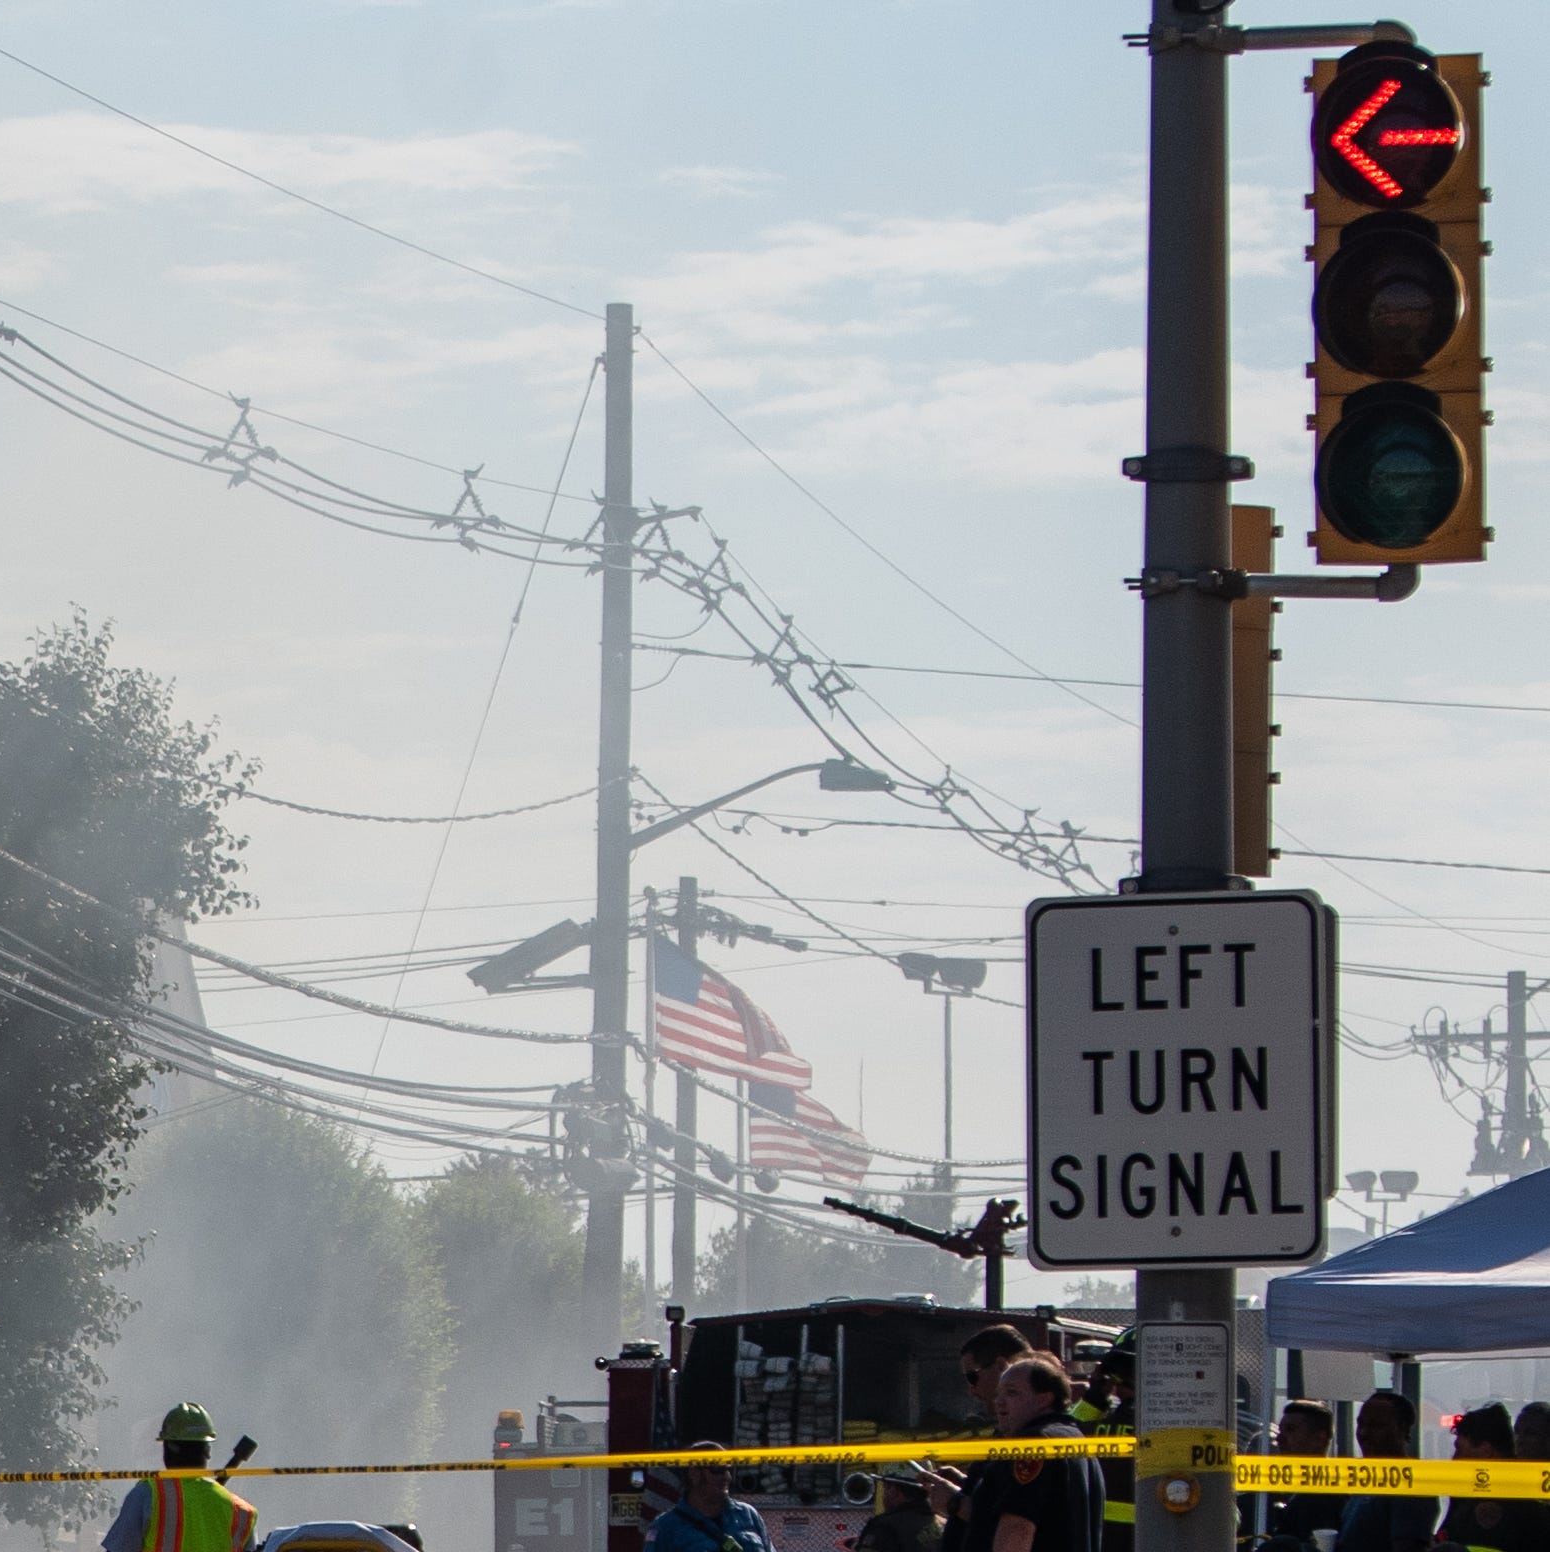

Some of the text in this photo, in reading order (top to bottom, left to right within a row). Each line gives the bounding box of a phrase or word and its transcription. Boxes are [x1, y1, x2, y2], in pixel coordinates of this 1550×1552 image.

[1092, 943, 1255, 1011] LEFT
[1082, 1046, 1268, 1114] TURN
[1050, 1150, 1304, 1219] SIGNAL
[515, 1498, 576, 1536] E1
